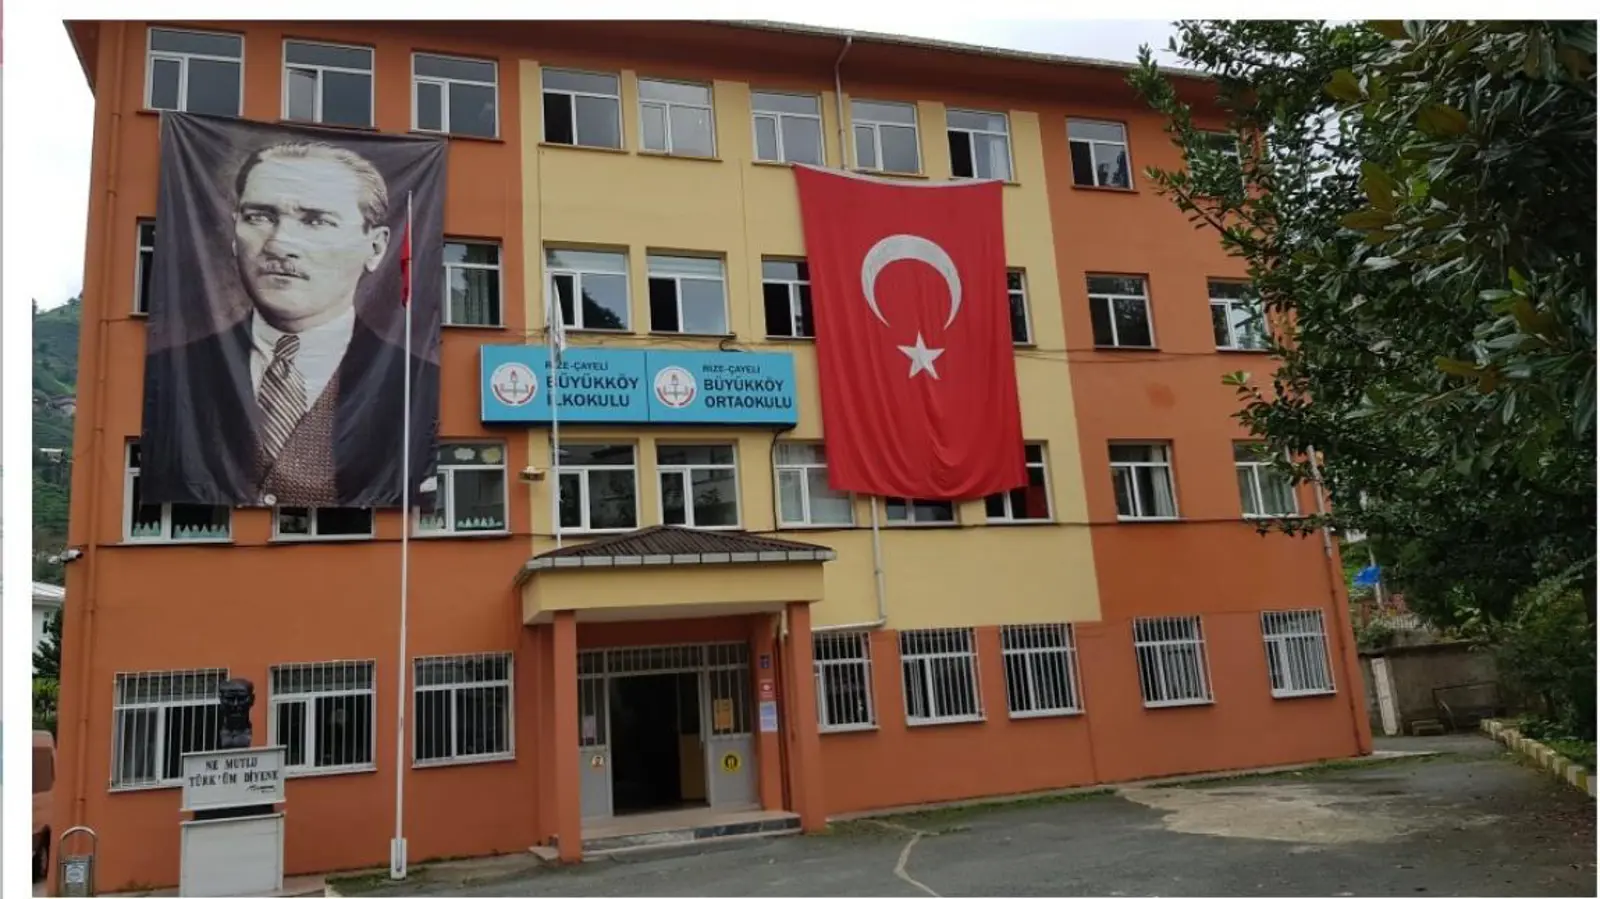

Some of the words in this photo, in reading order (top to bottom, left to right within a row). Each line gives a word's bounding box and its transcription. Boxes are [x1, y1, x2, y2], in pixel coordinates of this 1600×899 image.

[545, 359, 609, 371] RZE-ÇAYELİ
[546, 373, 639, 390] BÜYÜKKÖY
[703, 376, 784, 392] BÜYÜKKÖY
[704, 395, 792, 409] ORTAOKULU
[205, 759, 219, 771] NE
[225, 757, 258, 769] MUTLU
[244, 769, 279, 783] DİYENE
